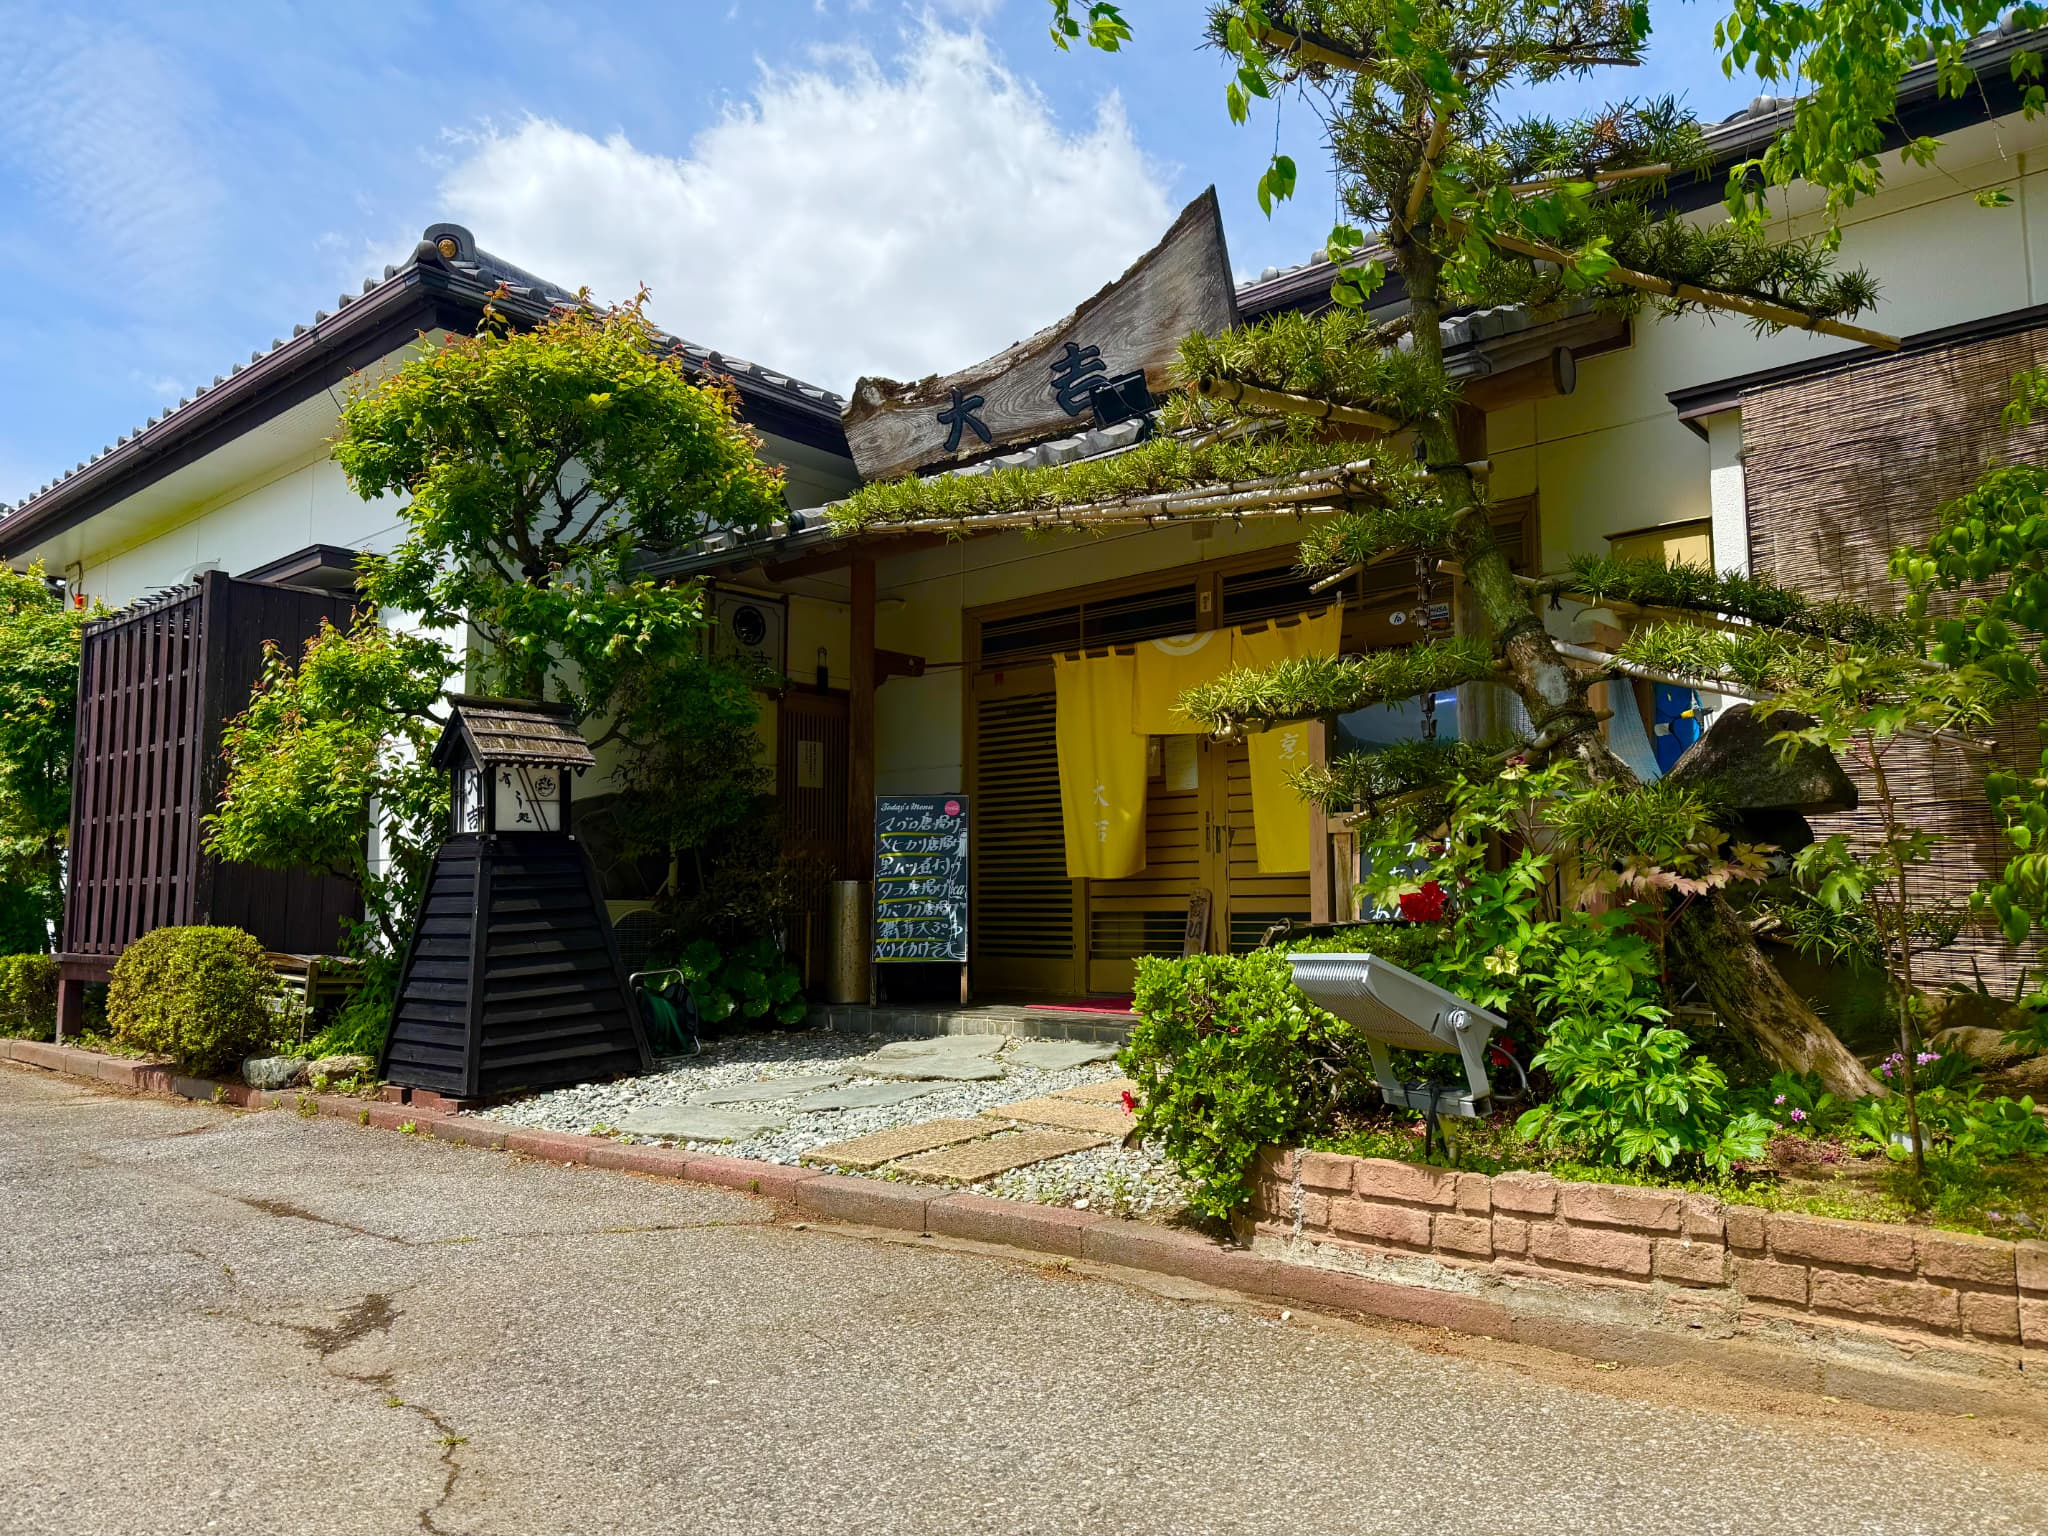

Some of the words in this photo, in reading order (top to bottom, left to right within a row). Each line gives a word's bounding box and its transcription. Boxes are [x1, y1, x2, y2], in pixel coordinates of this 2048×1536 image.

[937, 342, 1110, 452] 大吉
[881, 802, 909, 813] Today's
[910, 802, 934, 811] Menu
